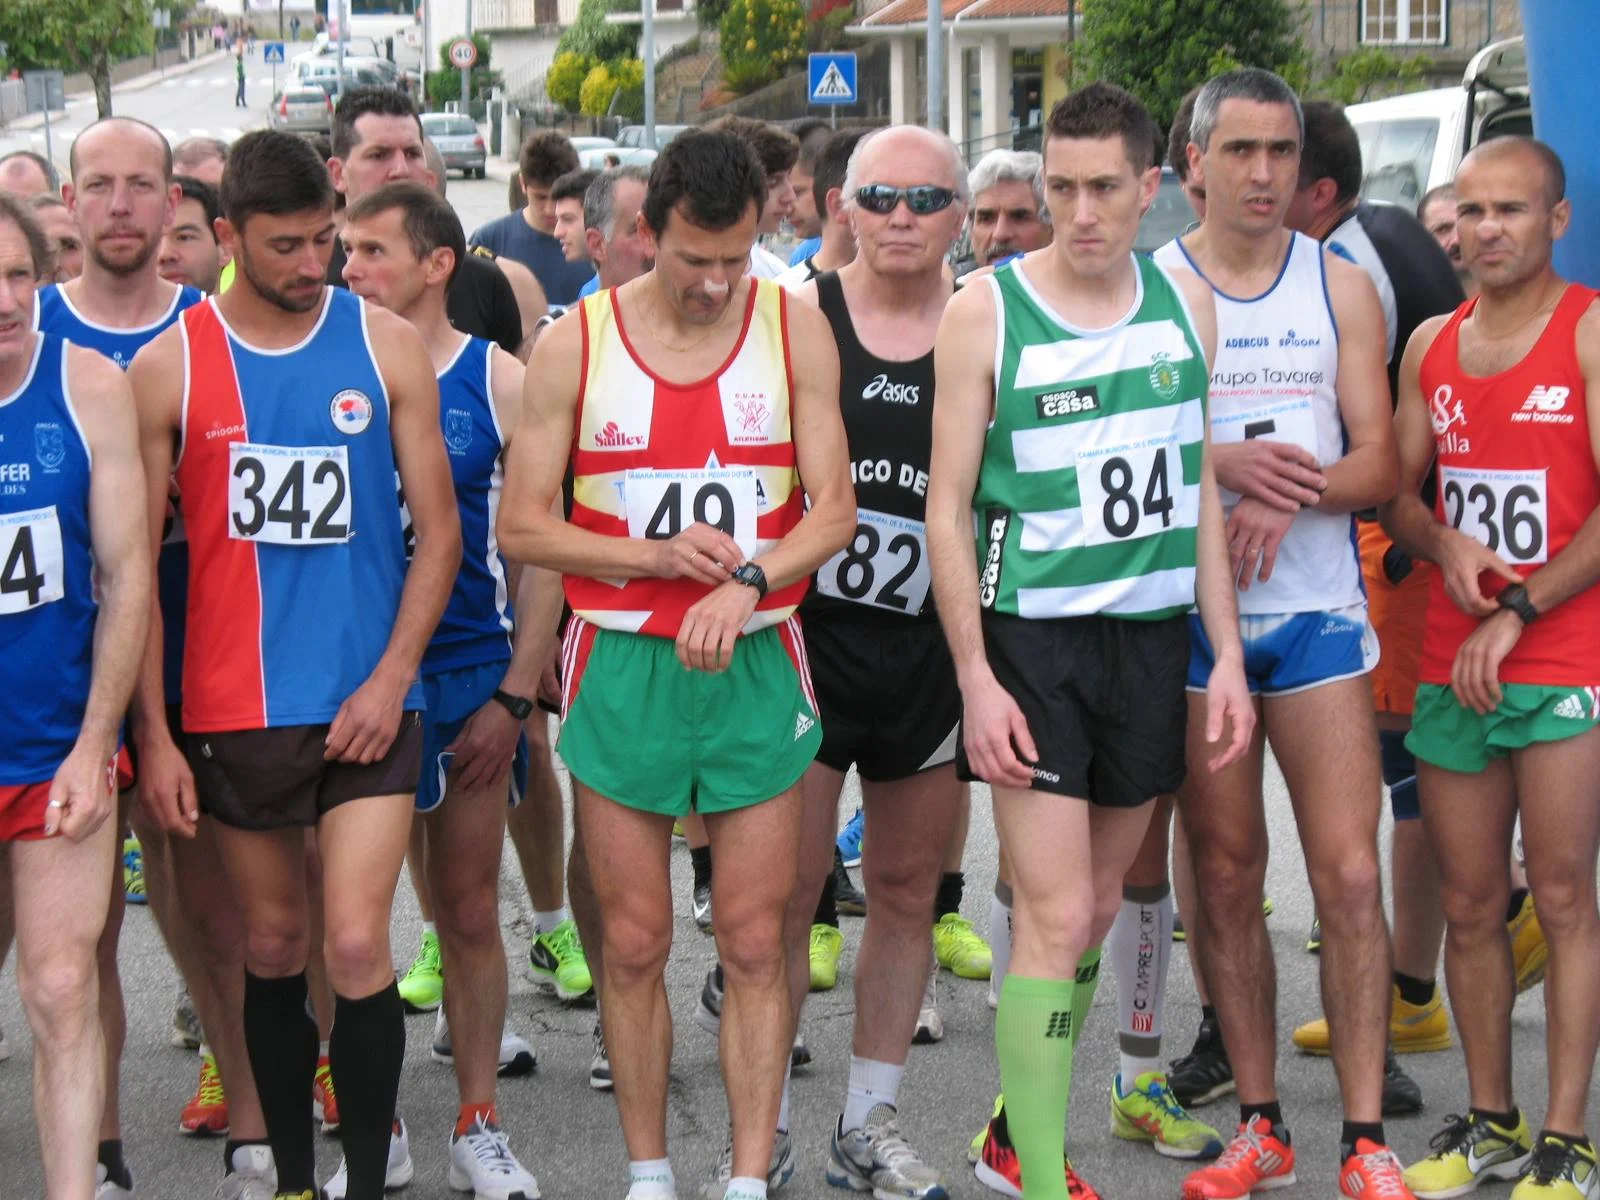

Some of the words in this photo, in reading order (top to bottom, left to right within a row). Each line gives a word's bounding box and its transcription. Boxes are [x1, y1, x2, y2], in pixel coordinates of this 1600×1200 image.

[455, 47, 472, 59] 40
[1225, 337, 1270, 349] ADERCUS
[1209, 371, 1257, 387] rupo
[1262, 368, 1324, 384] Tavares
[1041, 390, 1077, 404] espaço
[1043, 395, 1095, 417] casa
[1521, 384, 1570, 411] NB
[1511, 411, 1531, 422] new
[1532, 411, 1574, 424] balance
[655, 471, 689, 479] MUNICIPAL
[898, 463, 929, 497] DE
[232, 457, 348, 539] 342
[1100, 447, 1174, 538] 84
[645, 482, 735, 540] 49
[1445, 480, 1543, 560] 236
[0, 525, 45, 606] 4
[836, 523, 921, 611] 82
[981, 518, 1006, 608] casa
